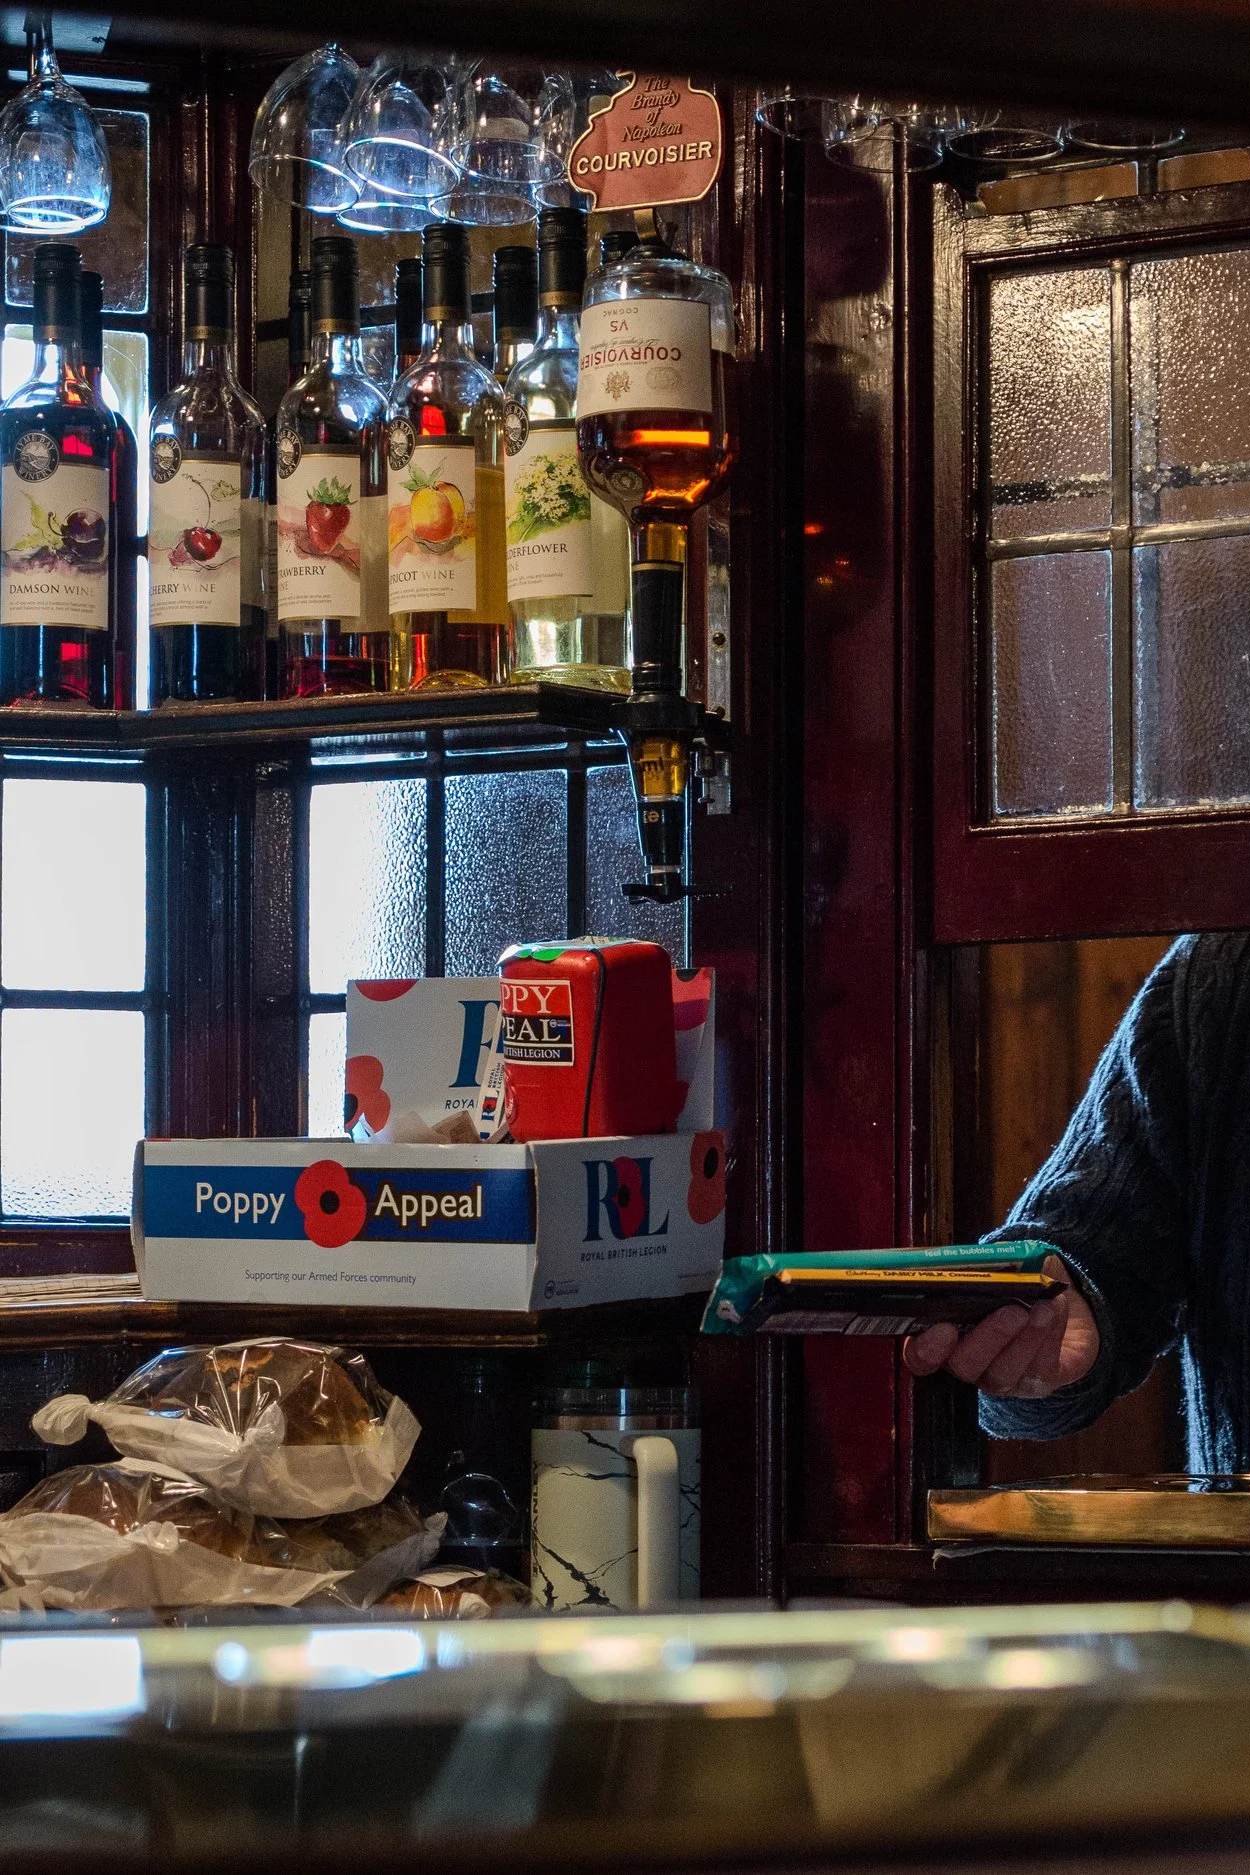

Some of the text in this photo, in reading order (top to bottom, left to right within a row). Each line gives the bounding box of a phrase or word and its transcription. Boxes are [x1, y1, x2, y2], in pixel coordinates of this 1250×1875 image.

[644, 75, 669, 92] The
[630, 91, 680, 110] Brandy
[646, 106, 662, 126] of
[621, 122, 683, 143] Napoleon
[576, 140, 713, 175] COURVOISIER
[603, 307, 639, 317] COGNAC
[610, 319, 629, 332] VS
[580, 346, 682, 371] COURVOISIER
[40, 435, 56, 451] BAY
[18, 465, 53, 480] WINERY
[507, 543, 568, 559] DERFLOWER
[279, 565, 327, 578] RAWBERRY
[390, 570, 455, 584] PRICOT WINE
[9, 583, 95, 597] DAMSON WINE
[500, 984, 556, 1013] PPY
[501, 1017, 561, 1041] EAL
[523, 1048, 561, 1058] LEGION
[445, 1099, 478, 1110] ROYA
[196, 1182, 482, 1227] Poppy Appeal
[580, 1245, 667, 1263] ROYAL BRITISH LEGION
[924, 1248, 942, 1257] feel
[960, 1247, 995, 1255] bubbles
[245, 1269, 417, 1286] Supporting our Armed Forces community
